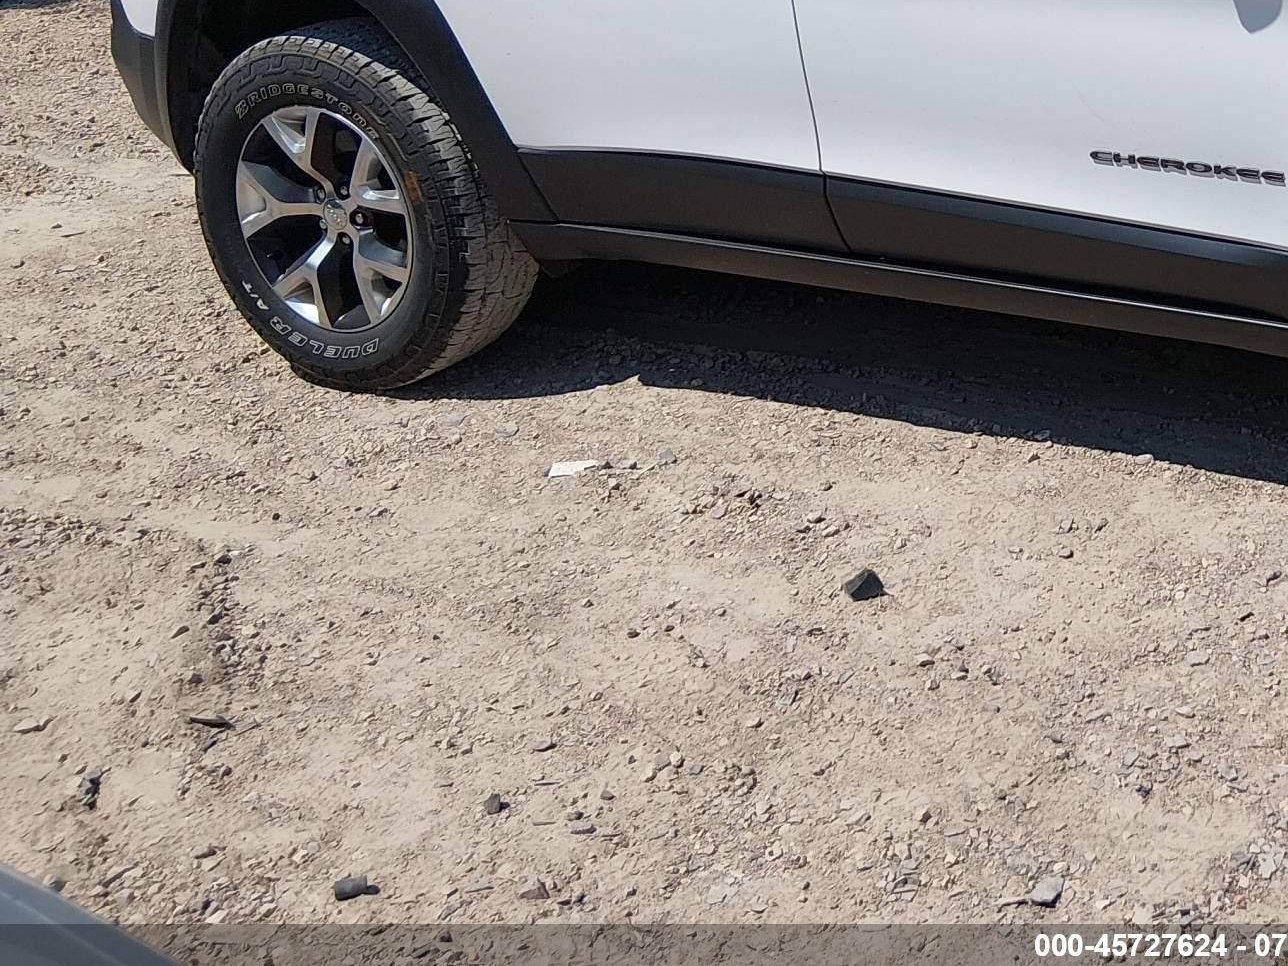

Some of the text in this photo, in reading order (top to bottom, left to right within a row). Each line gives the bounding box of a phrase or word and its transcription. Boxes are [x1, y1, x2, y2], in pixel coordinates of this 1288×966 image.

[234, 82, 380, 141] BRIDGESTONE
[1089, 150, 1287, 187] CHEROKEE
[268, 316, 380, 360] DUELER
